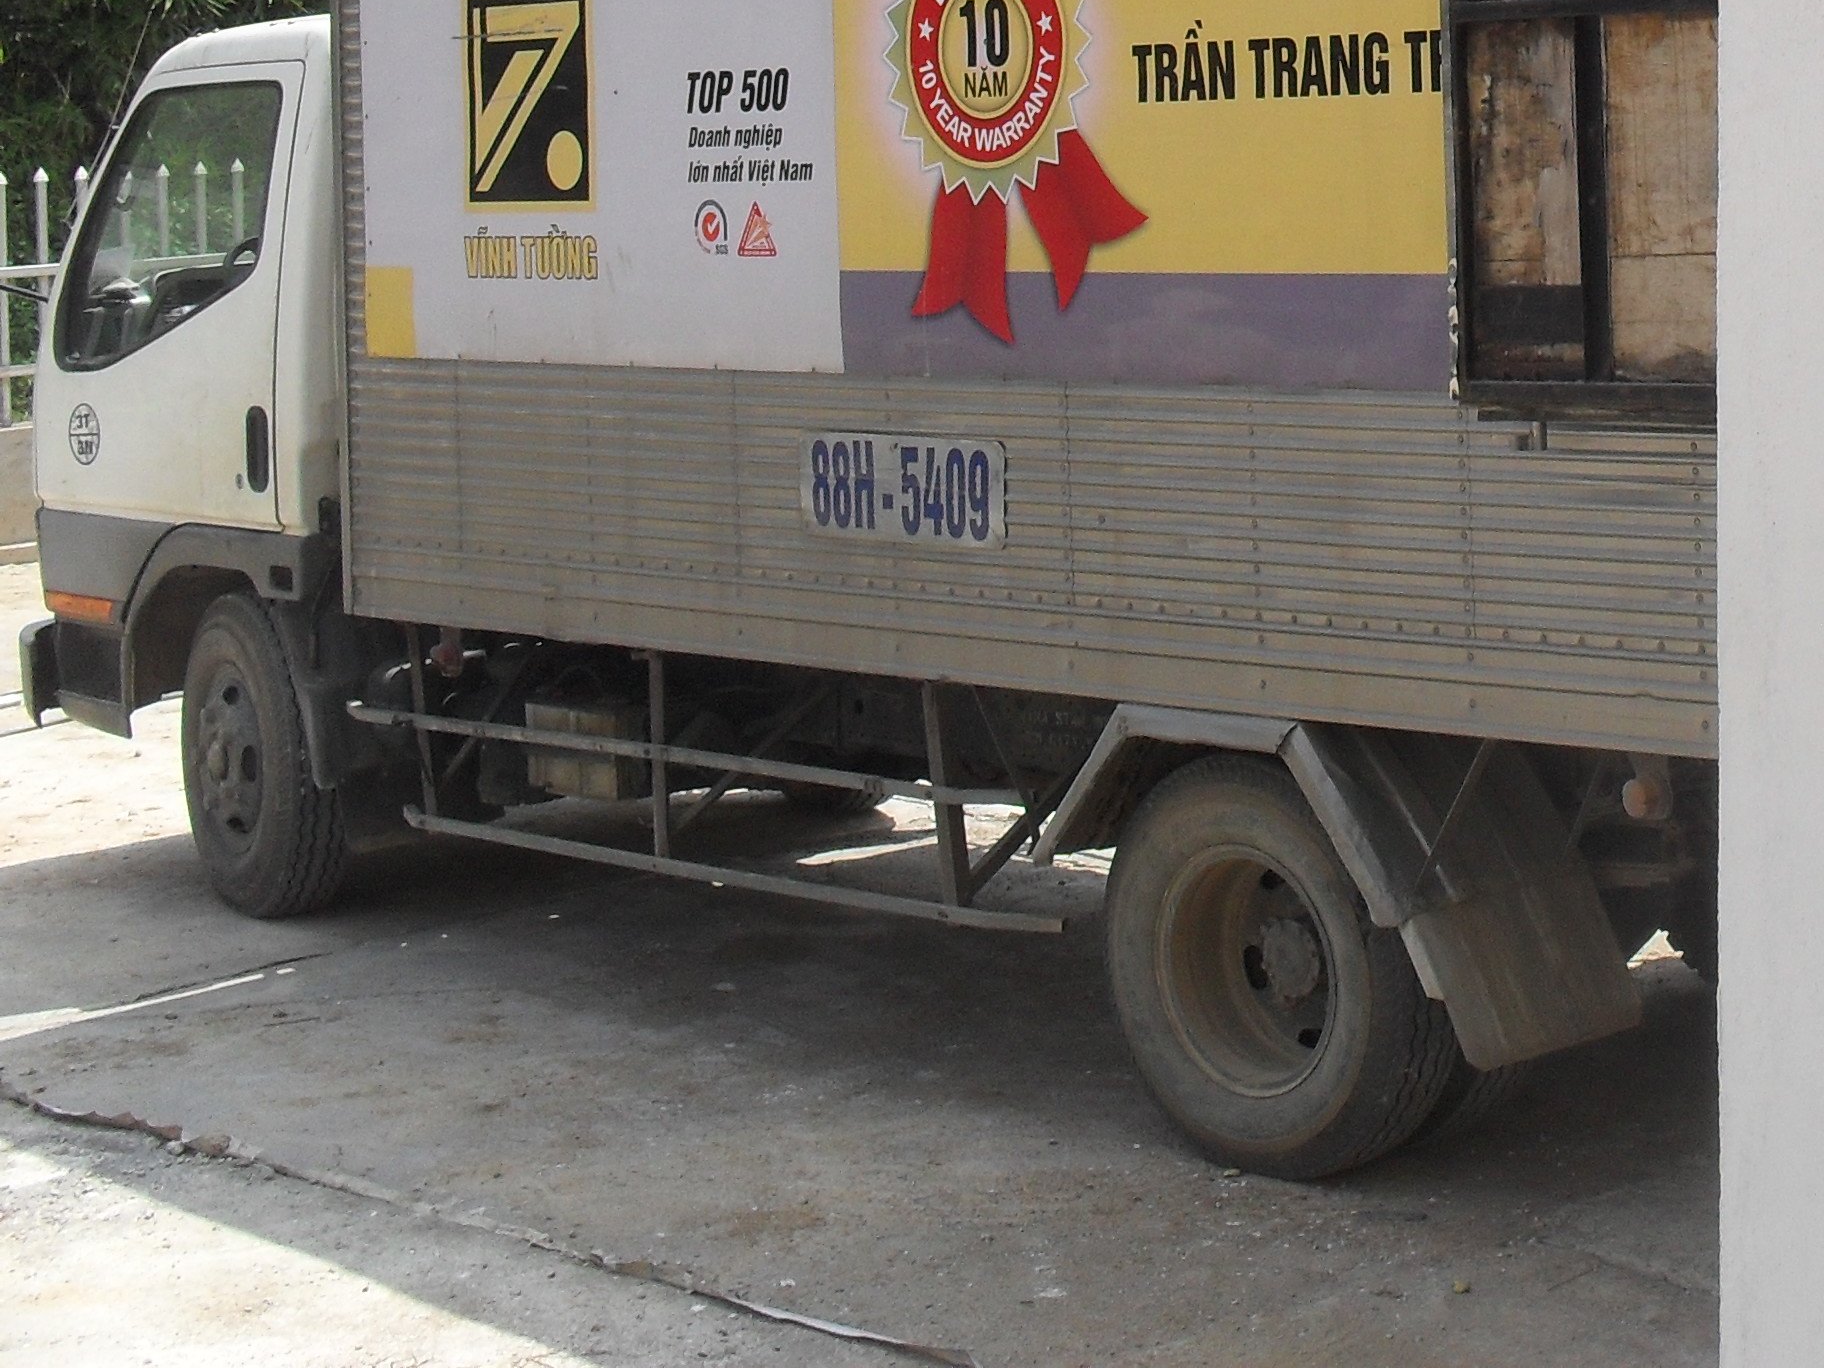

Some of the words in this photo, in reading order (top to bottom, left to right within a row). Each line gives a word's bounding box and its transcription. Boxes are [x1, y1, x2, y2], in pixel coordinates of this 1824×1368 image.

[964, 65, 1009, 98] NĂM
[1131, 20, 1236, 103] TRẦN
[1248, 32, 1390, 99] TRANG
[686, 70, 734, 114] TOP
[740, 67, 789, 112] 500
[918, 59, 937, 89] 10
[929, 88, 973, 148] YEAR
[974, 46, 1056, 152] WARRANTY
[688, 125, 731, 148] Doanh
[734, 123, 783, 151] nghiệp
[688, 160, 710, 183] lớn
[713, 155, 744, 183] nhất
[748, 159, 775, 187] Việt
[779, 159, 813, 181] Nam
[464, 226, 517, 279] VĨNH
[521, 224, 598, 280] TƯỜNG
